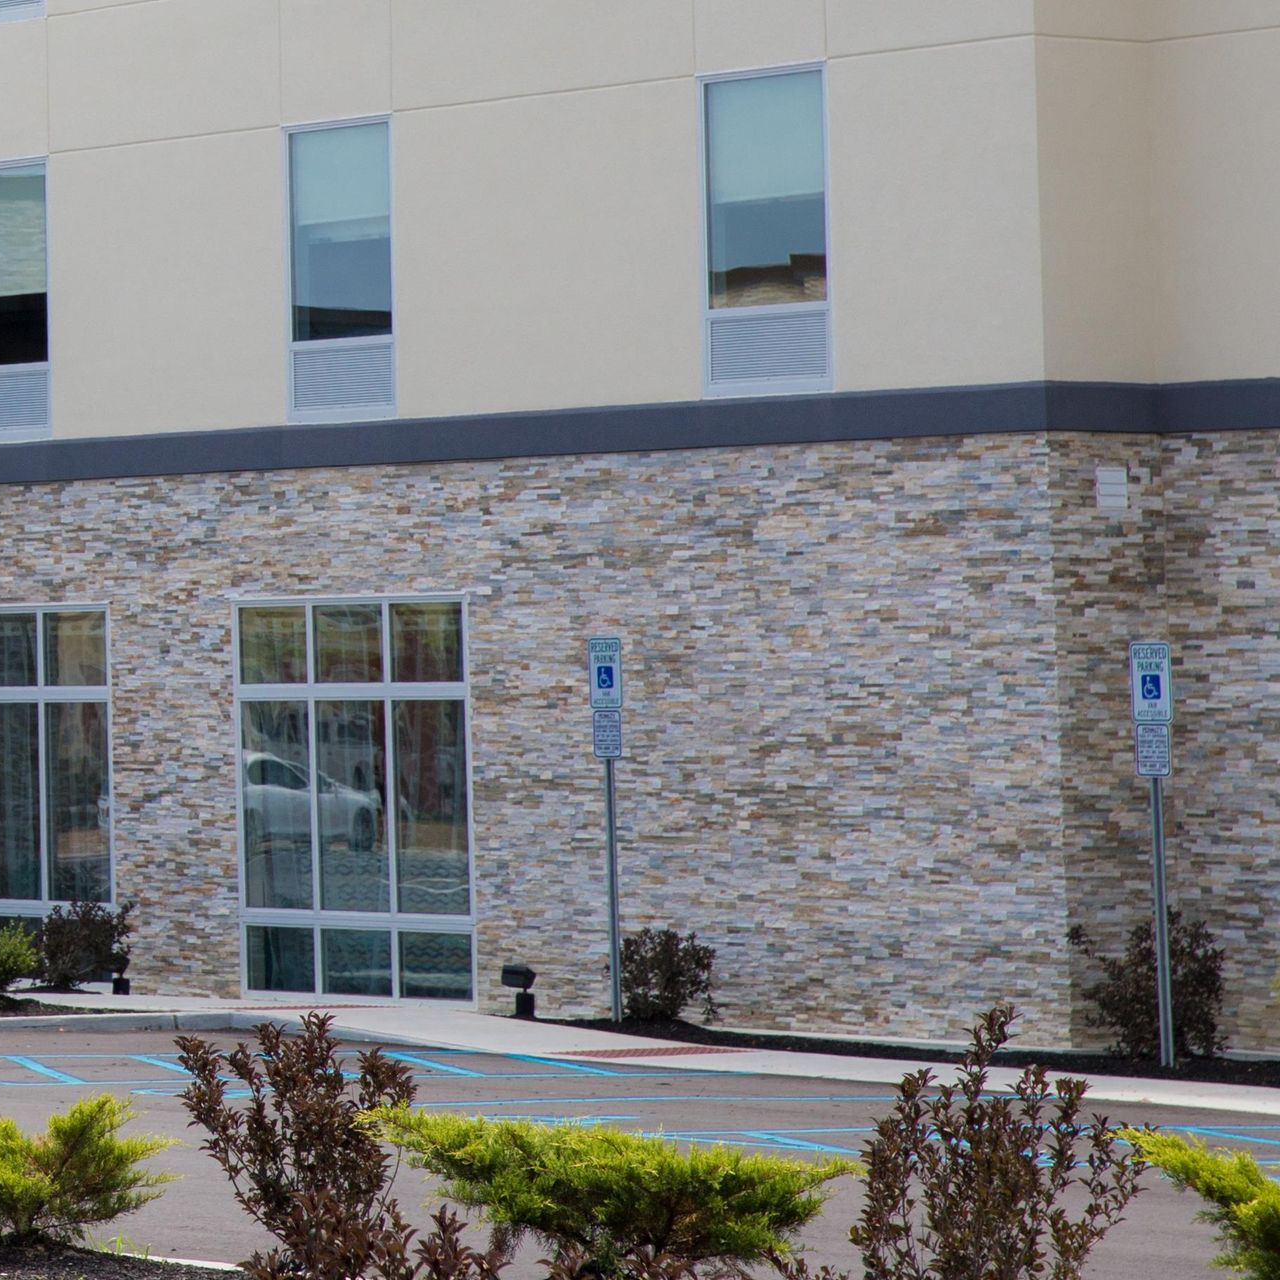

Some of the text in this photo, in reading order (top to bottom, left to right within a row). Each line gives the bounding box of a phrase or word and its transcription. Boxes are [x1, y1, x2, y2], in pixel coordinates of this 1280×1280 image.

[590, 641, 619, 653] RESERVED
[593, 654, 616, 664] PARKING
[1133, 647, 1167, 660] RESERVED
[1136, 661, 1164, 672] PARKING
